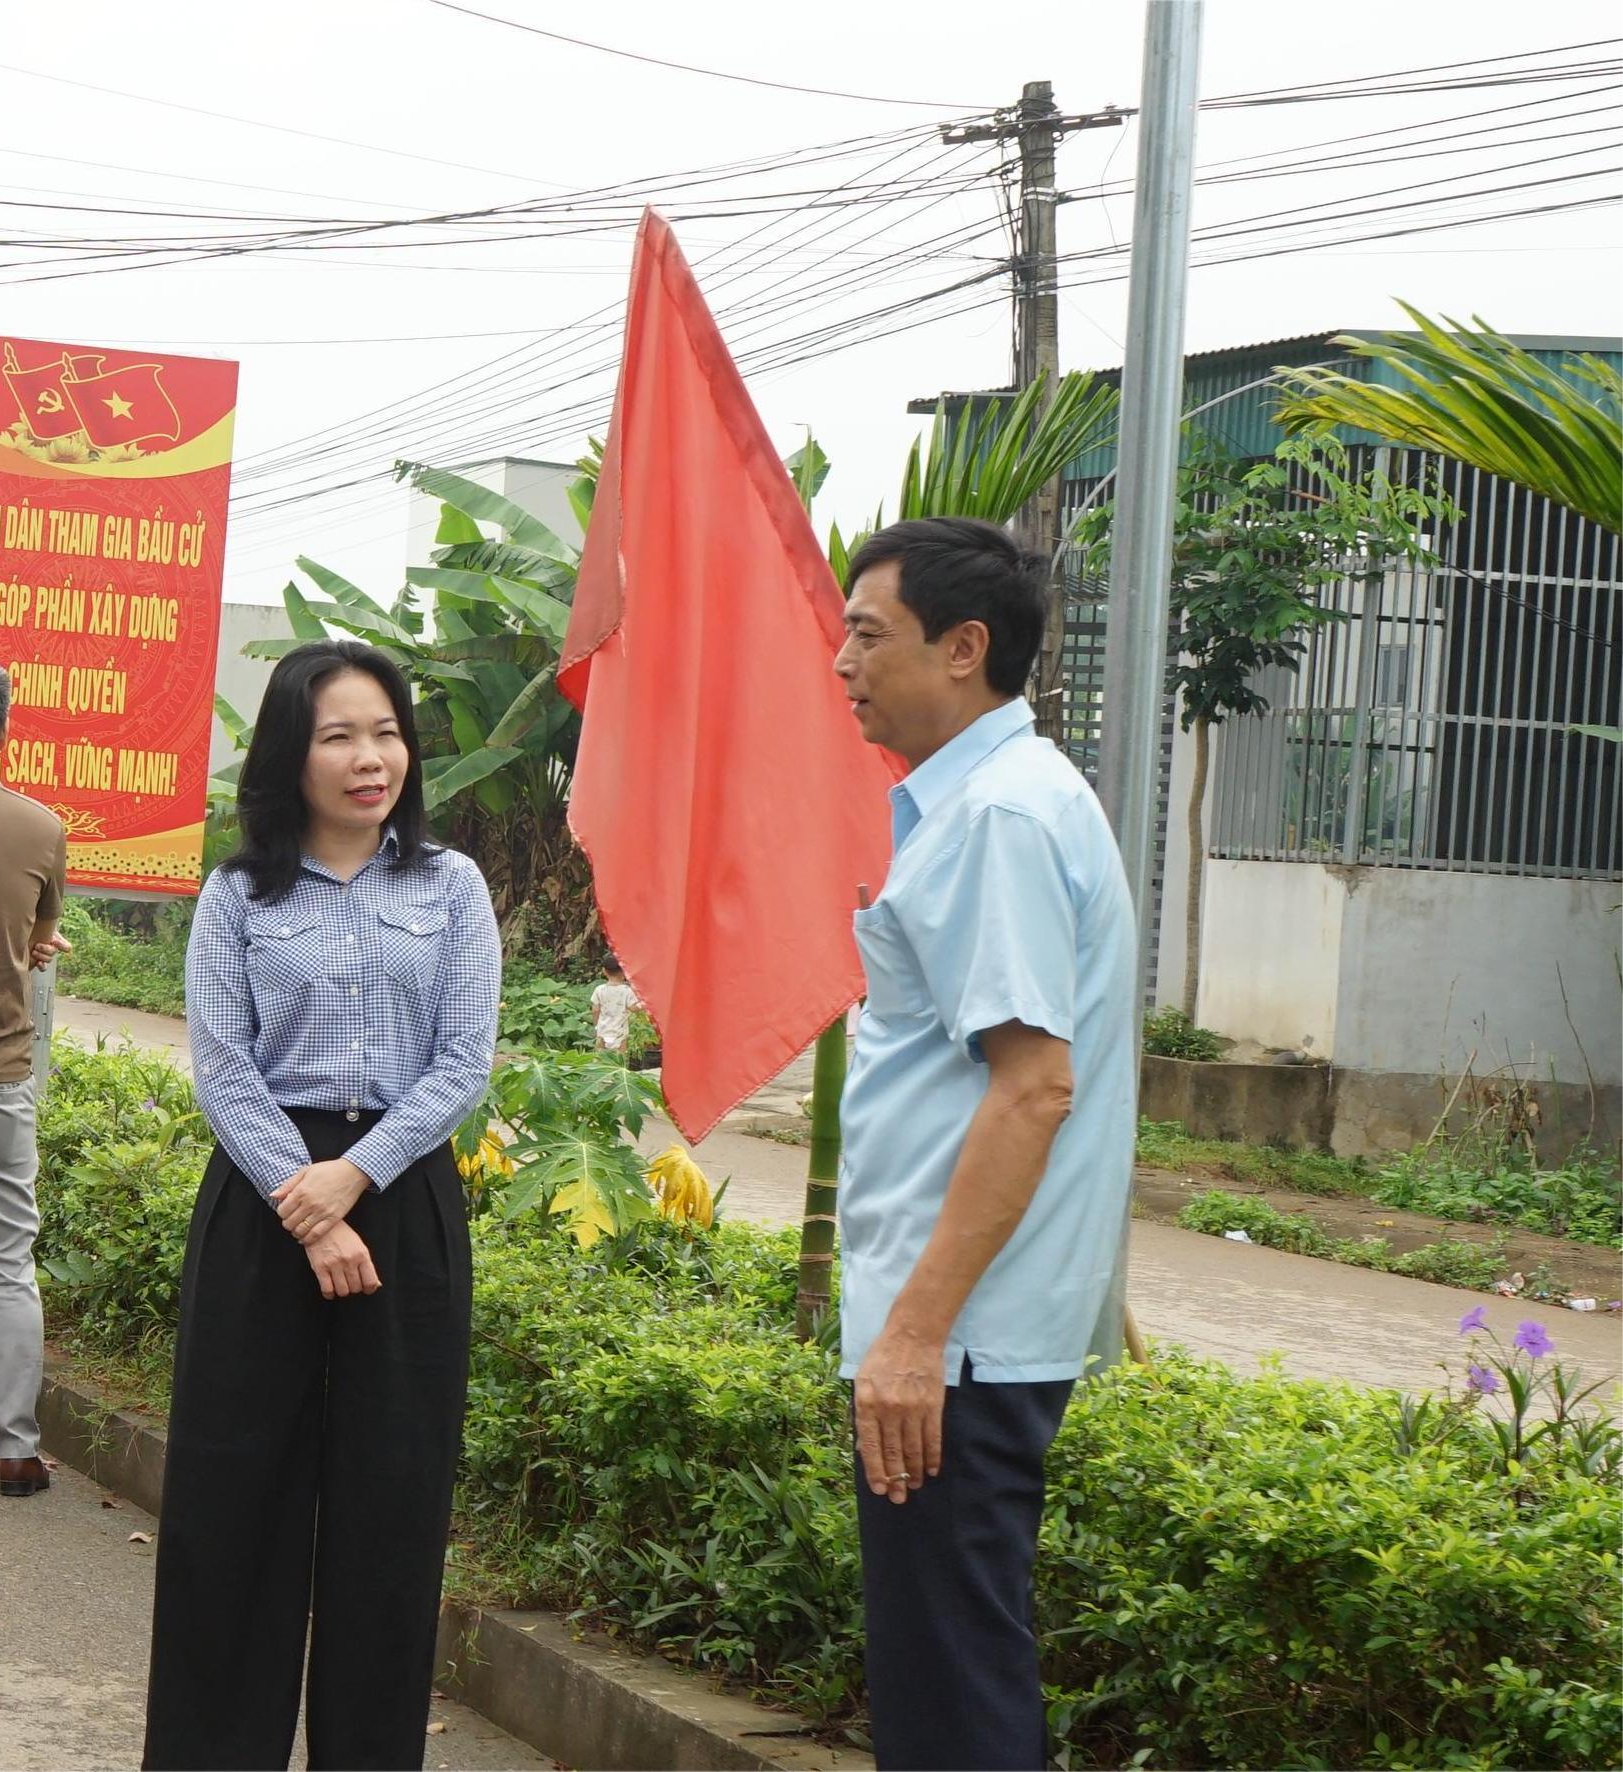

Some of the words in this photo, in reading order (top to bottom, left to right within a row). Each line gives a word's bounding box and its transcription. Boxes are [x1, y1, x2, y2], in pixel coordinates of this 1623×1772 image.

[4, 497, 44, 551] DÂN
[49, 509, 99, 557] THAM
[102, 515, 132, 560] GIA
[137, 505, 174, 565] BẦU
[178, 510, 206, 568] CỬ
[34, 573, 86, 633] PHẦN
[88, 583, 126, 637] XÂY
[128, 592, 178, 650] DỰNG
[8, 654, 64, 709] CHÍNH
[67, 656, 127, 715] QUYỀN
[6, 738, 59, 794] SẠCH,
[65, 736, 114, 791] VỮNG
[116, 748, 178, 804] MẠNH!
